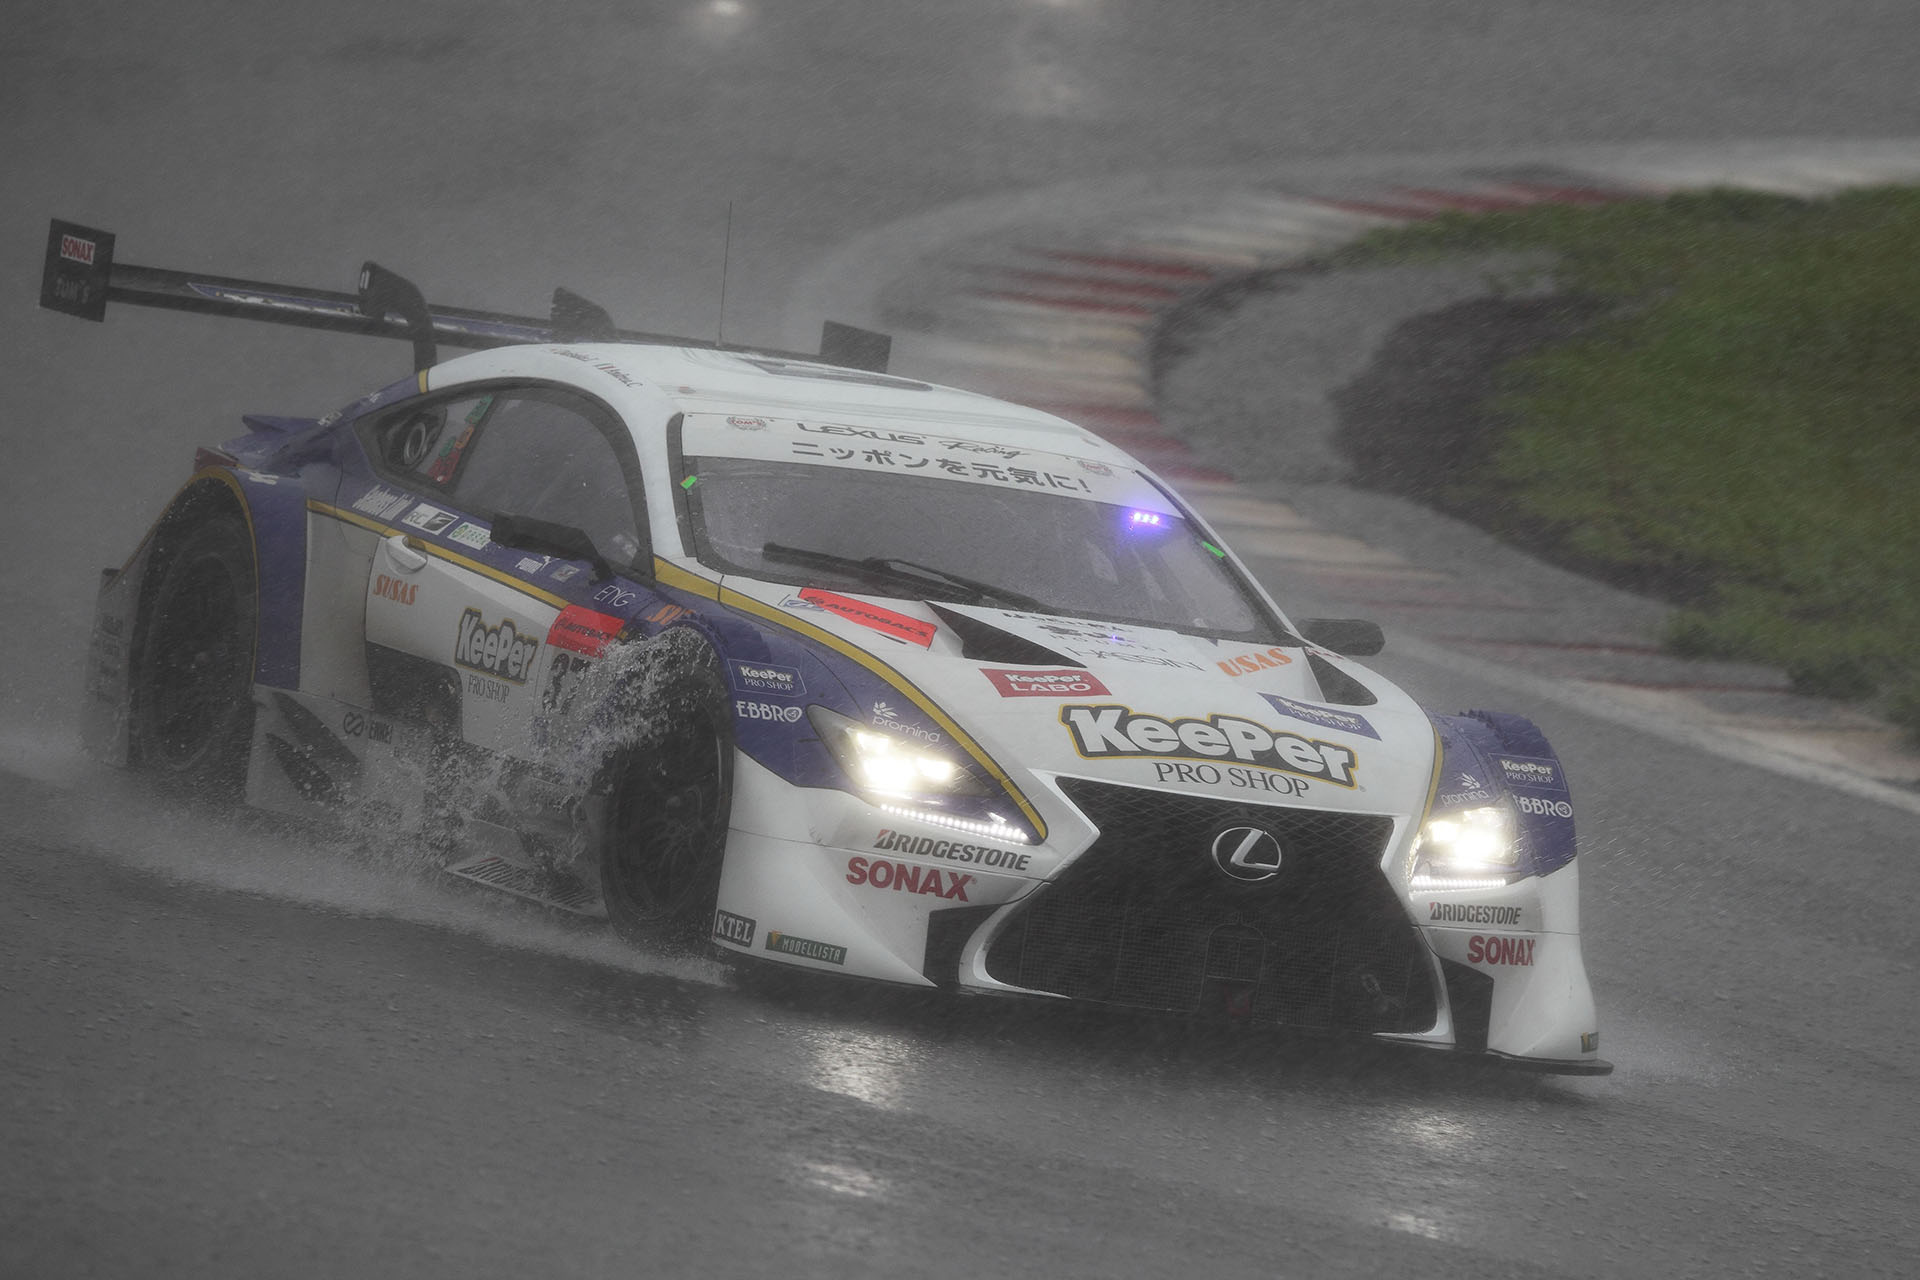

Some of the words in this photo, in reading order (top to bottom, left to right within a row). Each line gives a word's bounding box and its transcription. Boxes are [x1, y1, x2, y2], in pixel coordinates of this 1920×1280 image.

[62, 237, 94, 262] SONAX
[796, 422, 926, 445] LEXUS
[938, 440, 1032, 459] Racing
[456, 609, 537, 683] KeePer
[739, 665, 793, 682] KeePer
[744, 678, 765, 688] PRO
[766, 680, 794, 691] SHOP
[1004, 673, 1082, 683] KeePer
[467, 674, 486, 697] PRO
[487, 678, 510, 704] SHOP
[1009, 682, 1092, 692] LABO
[1064, 706, 1354, 787] KeePer
[1151, 762, 1221, 785] PRO
[1230, 768, 1311, 798] SHOP
[1501, 760, 1553, 775] KeePer
[1505, 771, 1526, 780] PRO
[1527, 773, 1554, 784] SHOP
[873, 829, 1032, 871] BRIDGESTONE
[845, 856, 974, 903] SONAX
[1429, 901, 1523, 925] BRIDGESTONE
[782, 937, 841, 961] MODELLISTA
[1467, 935, 1536, 966] SONAX
